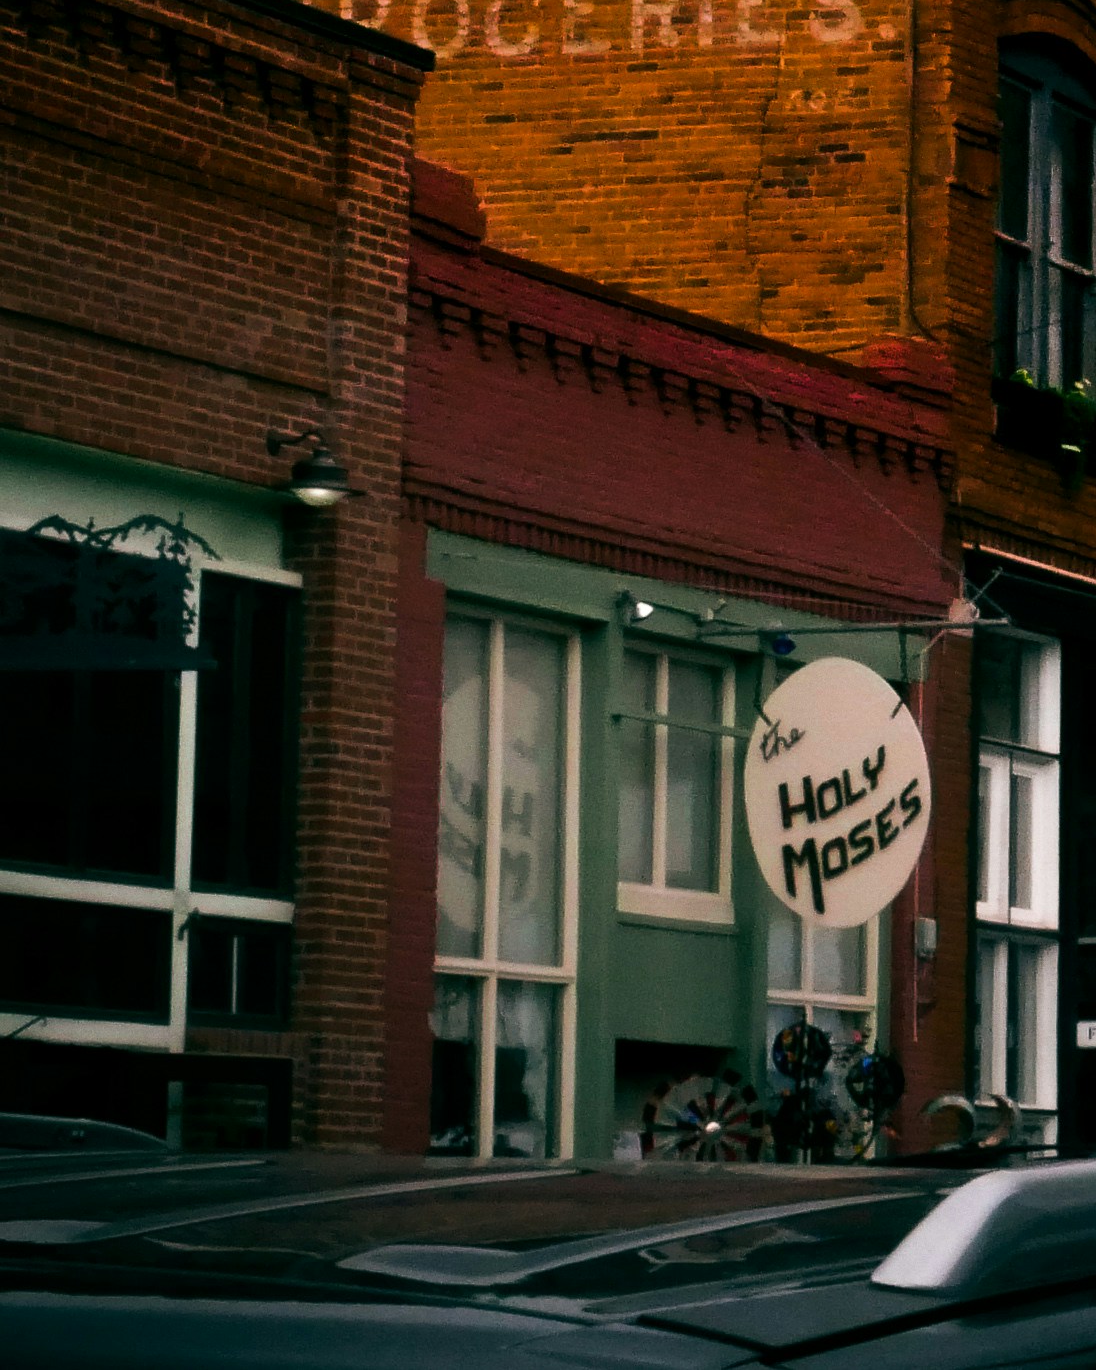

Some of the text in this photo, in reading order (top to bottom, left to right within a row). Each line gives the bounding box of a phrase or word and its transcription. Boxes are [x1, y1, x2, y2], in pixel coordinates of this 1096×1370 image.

[760, 719, 806, 764] the
[778, 745, 885, 830] HOLY
[781, 778, 922, 915] MOSES
